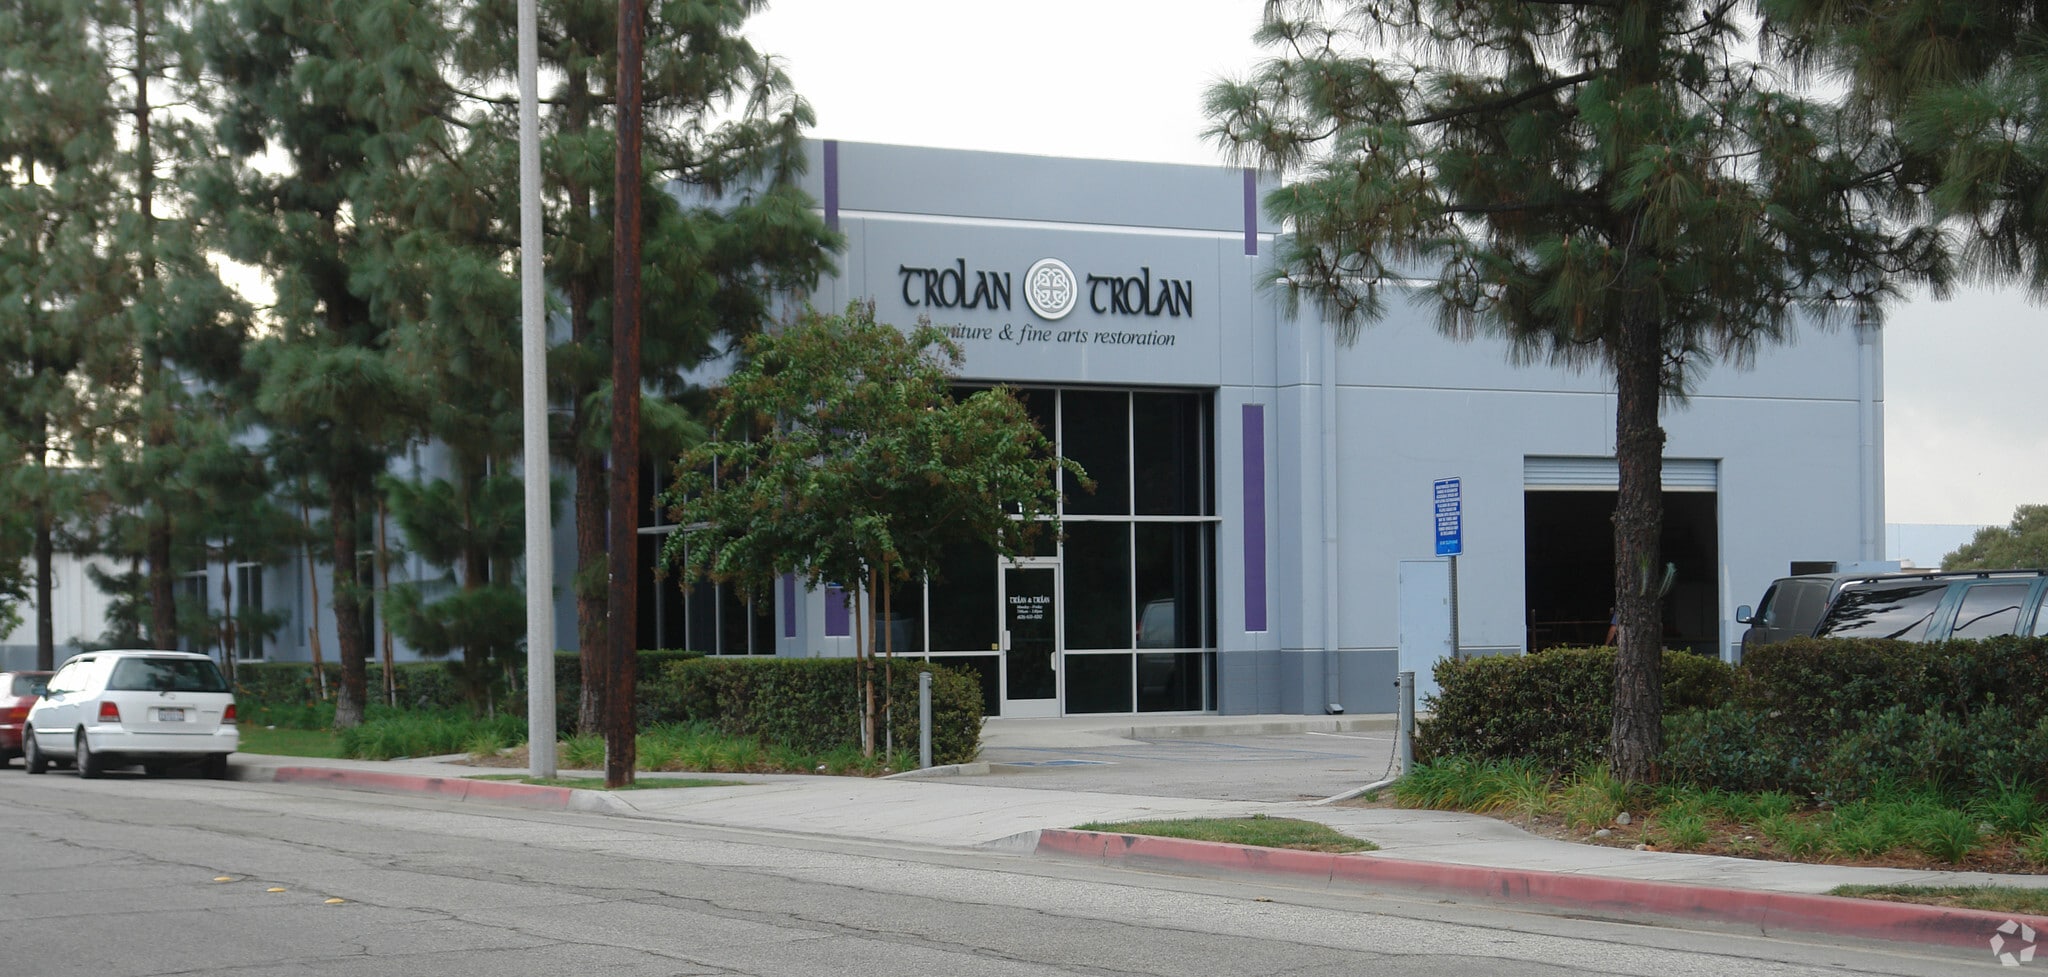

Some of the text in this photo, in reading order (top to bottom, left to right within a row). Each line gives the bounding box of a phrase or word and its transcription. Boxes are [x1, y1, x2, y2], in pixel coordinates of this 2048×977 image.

[899, 258, 1192, 318] TROLAN TROLAN
[998, 323, 1014, 340] &
[1016, 324, 1052, 346] fine
[1056, 329, 1088, 343] arts
[1093, 330, 1176, 346] restoration
